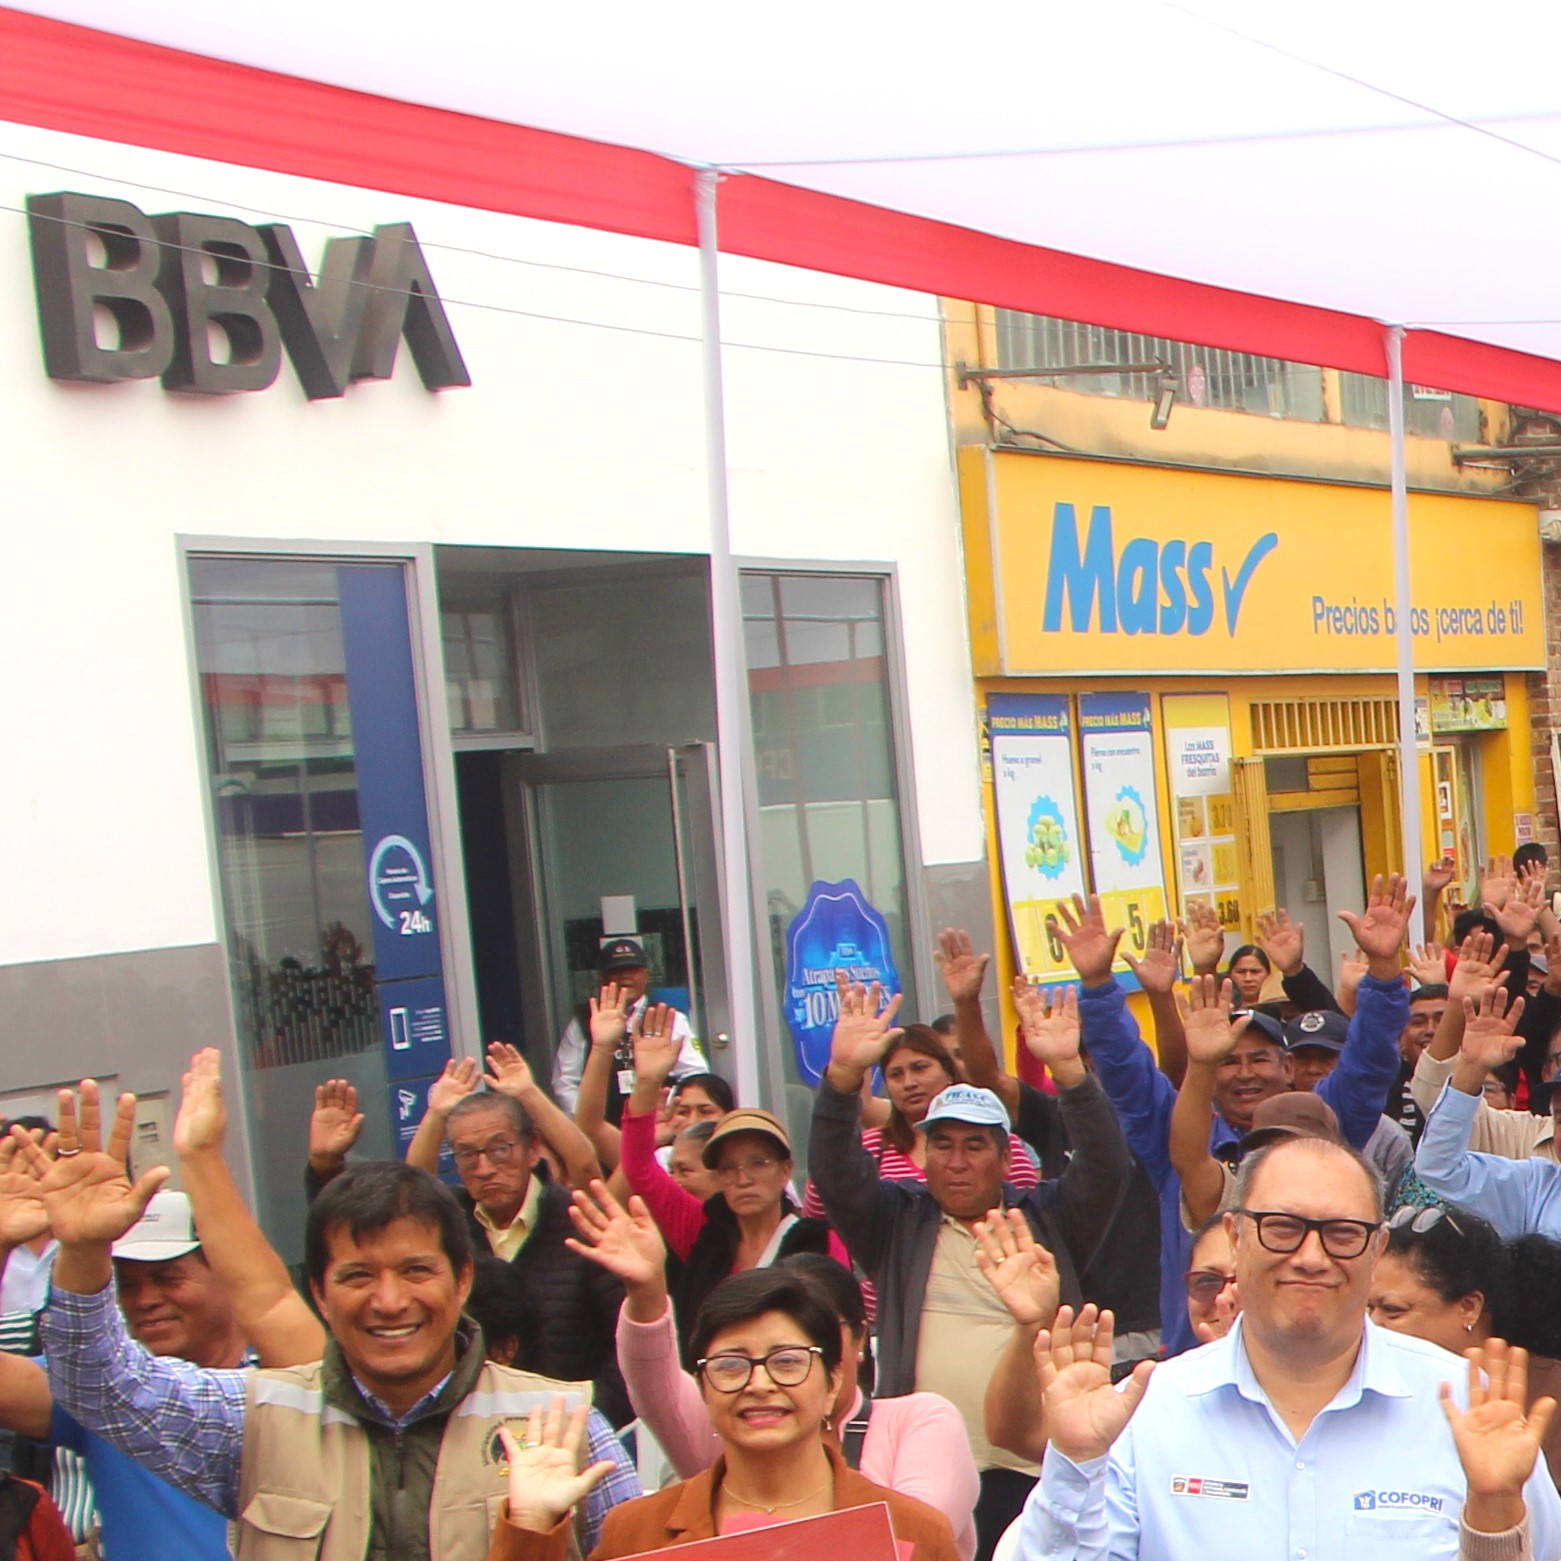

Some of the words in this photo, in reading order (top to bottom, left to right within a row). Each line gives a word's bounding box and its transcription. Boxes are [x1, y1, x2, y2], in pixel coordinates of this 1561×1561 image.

[27, 191, 473, 401] BBVA
[1042, 501, 1214, 636] Mass
[1312, 595, 1379, 634] Precios
[1383, 597, 1429, 634] bos
[1436, 604, 1483, 642] ¡cerca
[1487, 601, 1505, 634] de
[1509, 599, 1523, 634] ti!
[1034, 715, 1057, 728] MASS
[1120, 712, 1141, 725] MASS
[1196, 740, 1214, 750] MASS
[1181, 752, 1220, 765] FRESQUITAS
[400, 910, 433, 935] 24h
[1128, 903, 1144, 950] 5
[1378, 1491, 1443, 1512] COFOPRI
